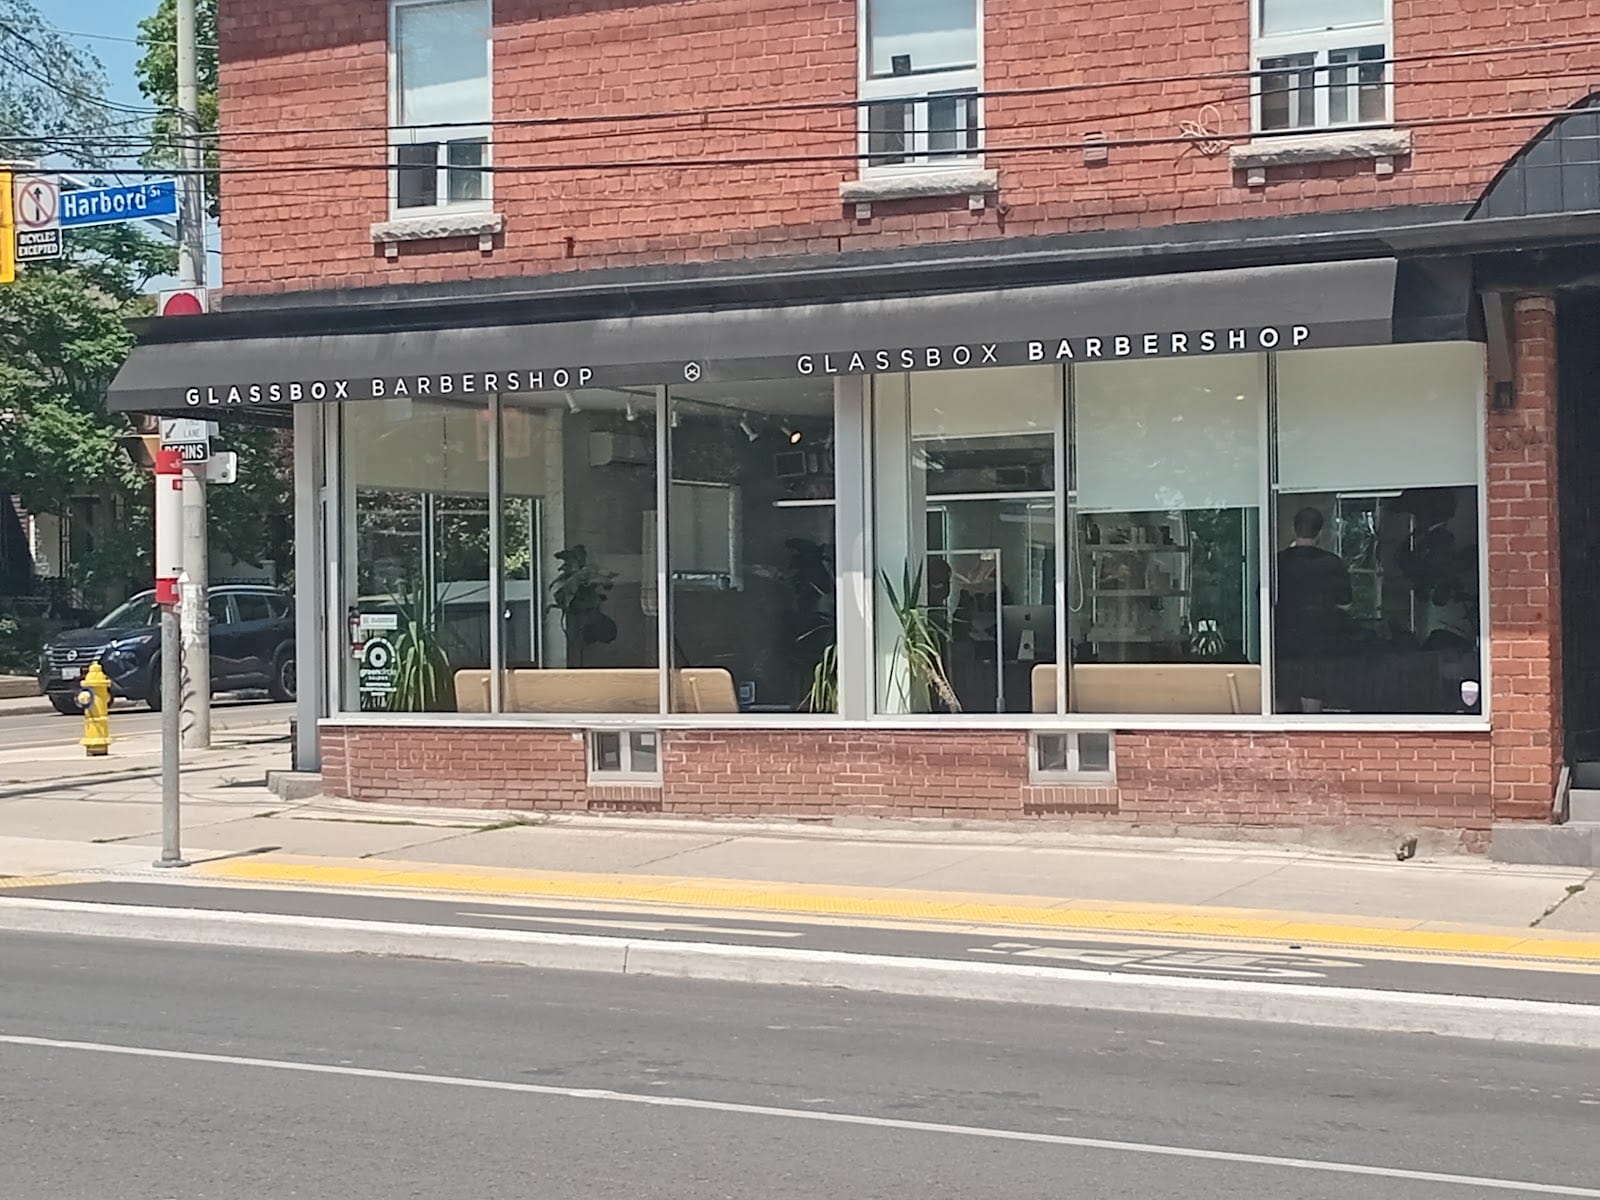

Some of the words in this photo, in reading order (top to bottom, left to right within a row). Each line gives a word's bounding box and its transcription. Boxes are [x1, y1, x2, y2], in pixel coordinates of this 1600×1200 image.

[64, 186, 147, 217] Harbord
[797, 343, 998, 375] GLASSBOX
[1028, 326, 1310, 361] BARBERSHOP
[185, 380, 349, 405] GLASSBOX
[371, 367, 594, 397] BARBERSHOP
